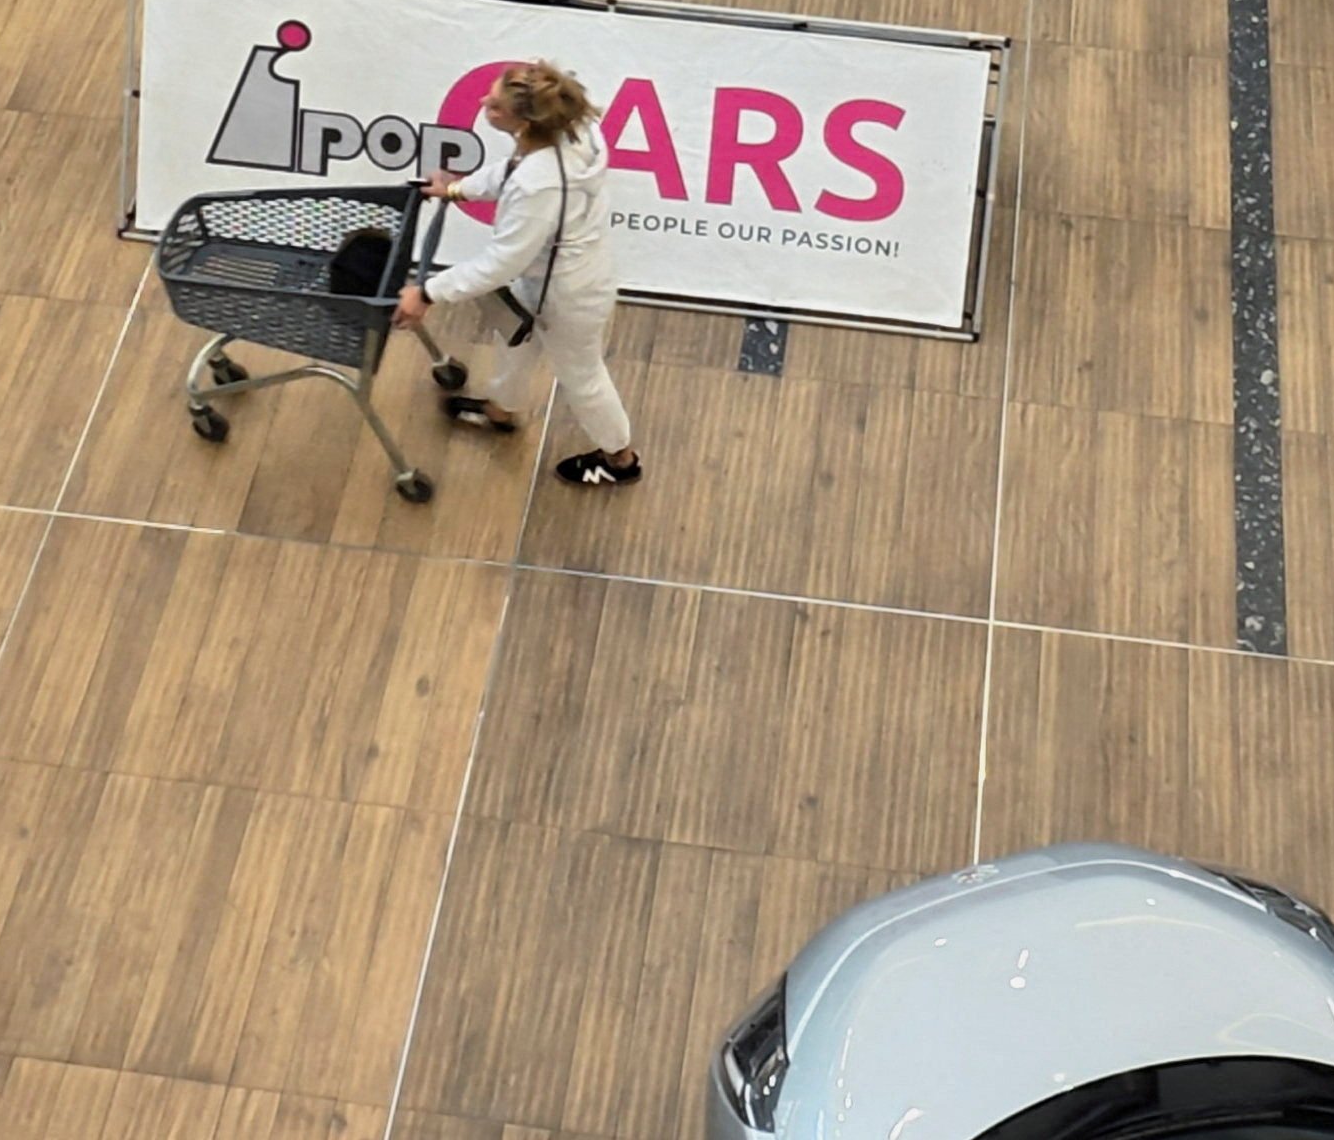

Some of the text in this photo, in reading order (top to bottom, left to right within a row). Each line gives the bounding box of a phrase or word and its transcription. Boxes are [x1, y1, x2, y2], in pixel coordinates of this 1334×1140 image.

[610, 212, 900, 258] PEOPLE OUR PASSION!
